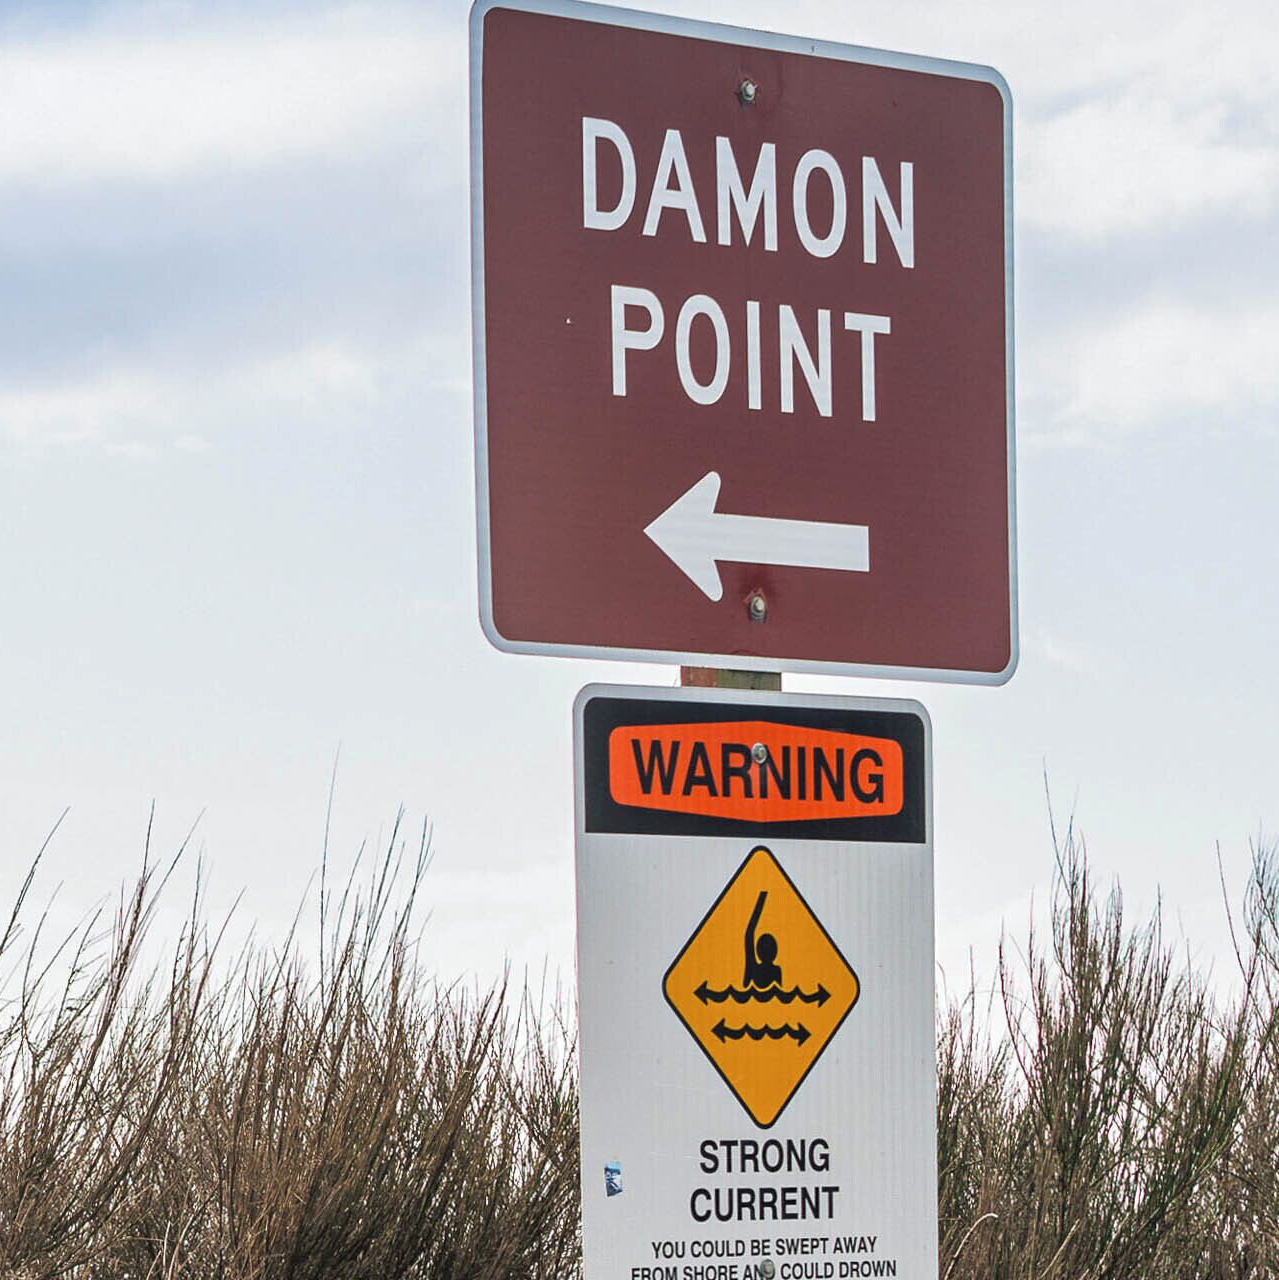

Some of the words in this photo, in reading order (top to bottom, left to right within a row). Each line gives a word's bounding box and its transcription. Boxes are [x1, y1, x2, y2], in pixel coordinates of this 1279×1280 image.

[582, 116, 915, 269] DAMON
[610, 284, 891, 422] POINT
[631, 738, 884, 804] WARNING
[699, 1138, 830, 1174] STRONG
[690, 1185, 840, 1223] CURRENT
[651, 1240, 686, 1260] YOU
[690, 1239, 745, 1259] COULD
[750, 1238, 772, 1257] BE
[775, 1237, 830, 1256] SWEPT
[832, 1235, 878, 1255] AWAY
[780, 1261, 835, 1280] COULD
[838, 1259, 897, 1279] DROWN
